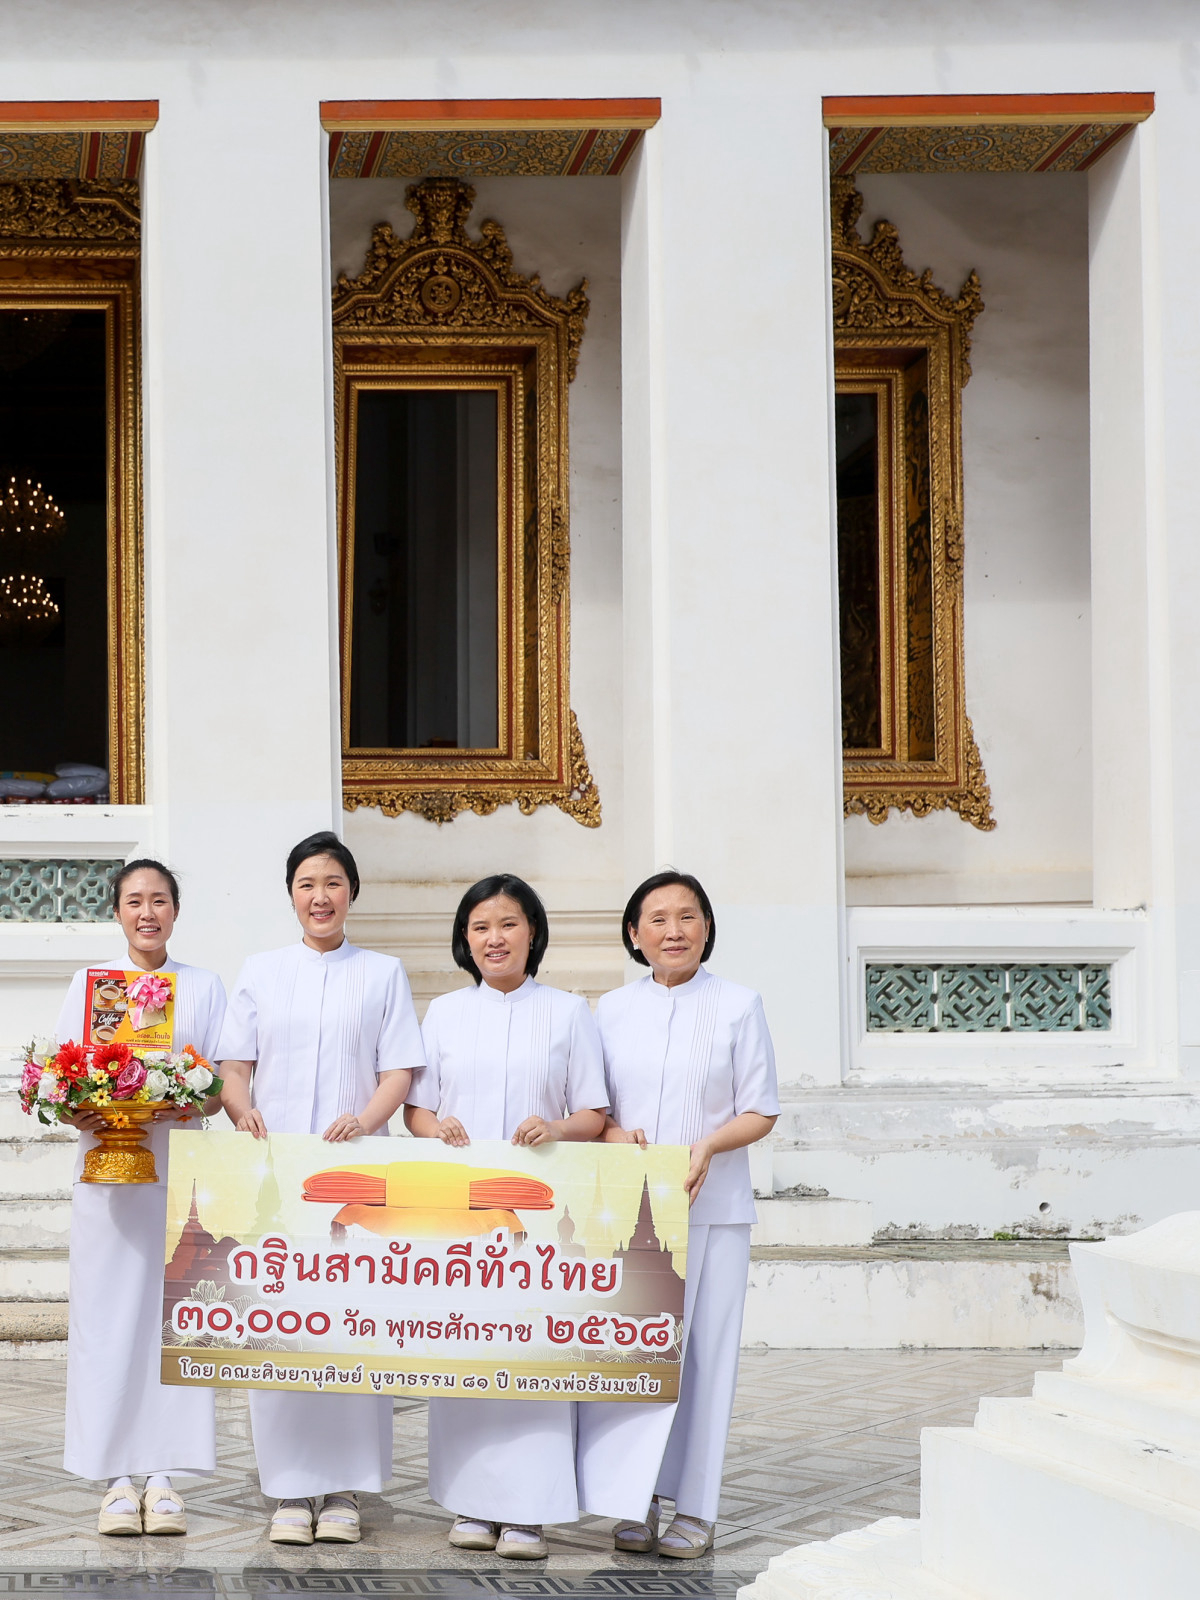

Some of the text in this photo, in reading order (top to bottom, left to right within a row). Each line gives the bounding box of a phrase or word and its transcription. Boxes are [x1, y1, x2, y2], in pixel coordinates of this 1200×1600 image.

[234, 1233, 617, 1294] กฐินสามัคคีทั่วไทย
[178, 1305, 669, 1349] ๓๐,๐๐๐ วัด พุทธศักราช ๒๕๖๘
[180, 1358, 660, 1393] โดย คณะศิษยานุศิษย์ บูชาธรรม ๘๑ ปี หลวงพ่อธัมมชโย
